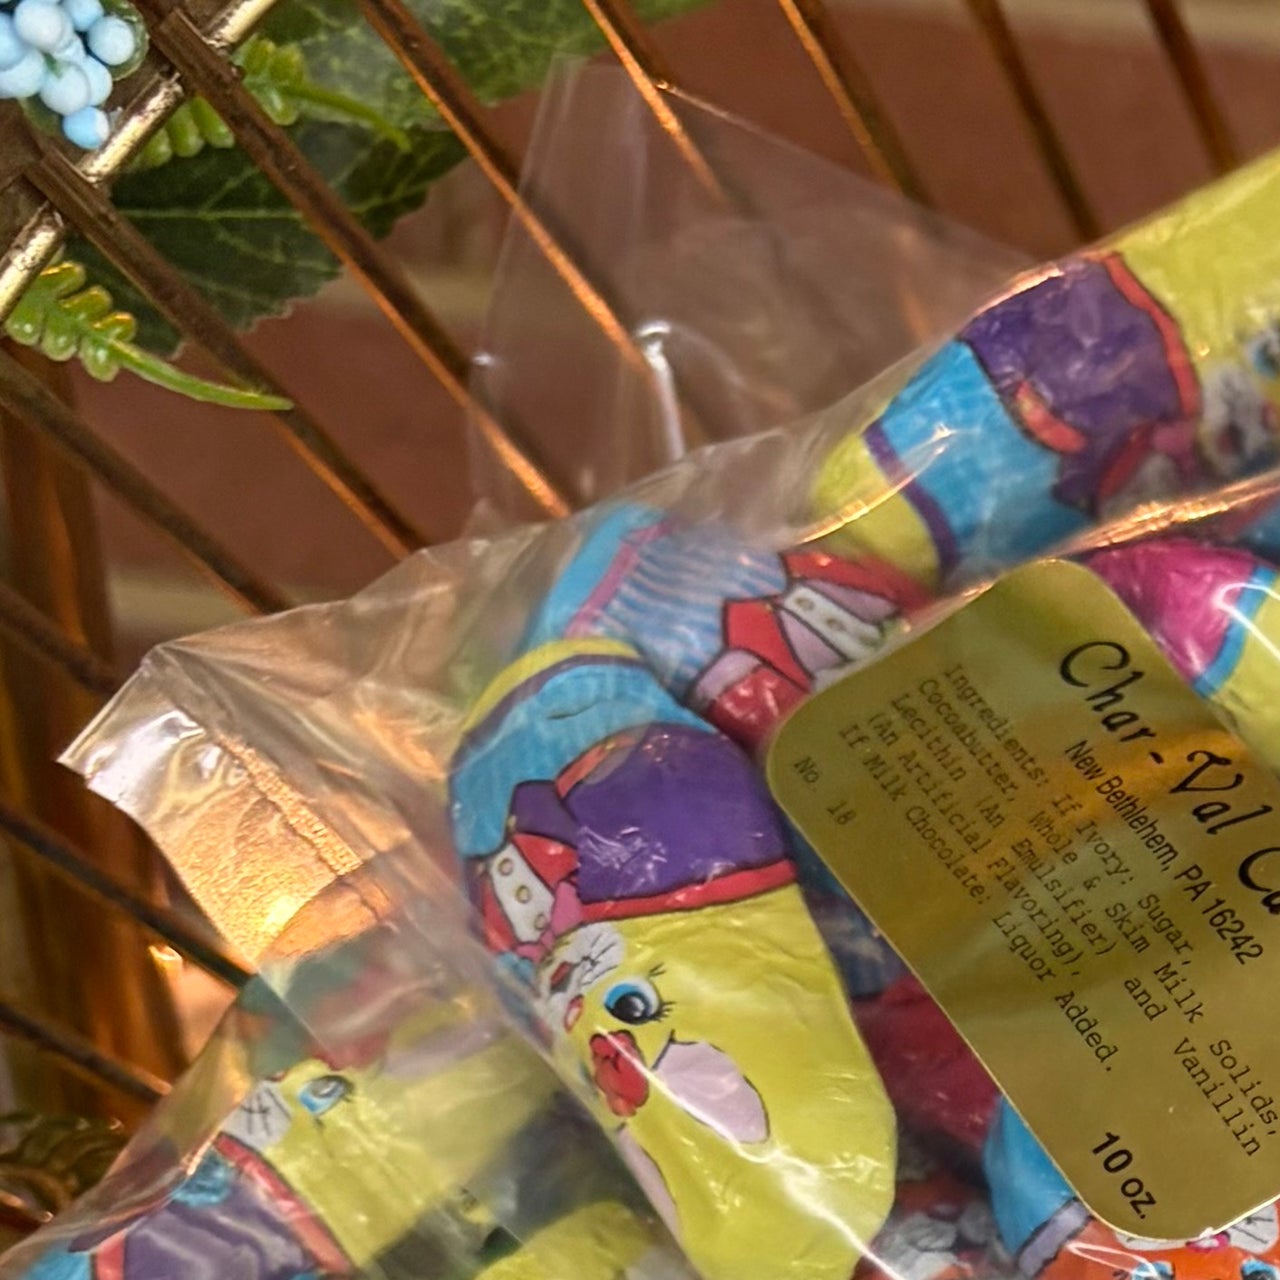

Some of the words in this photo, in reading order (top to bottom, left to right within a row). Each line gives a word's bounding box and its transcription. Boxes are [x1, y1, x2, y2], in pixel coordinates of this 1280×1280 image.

[838, 722, 870, 749] If
[861, 753, 907, 802] Milk
[904, 805, 991, 905] Chocolate:
[991, 910, 1057, 981] Liquor
[1053, 990, 1119, 1072] Added.
[868, 713, 900, 747] (An
[896, 749, 993, 855] Artificial
[985, 855, 1084, 976] Flavoring),
[889, 692, 967, 782] Lecithin
[975, 800, 1005, 829] (An
[1009, 836, 1117, 956] Emulsifier)
[1123, 977, 1168, 1021] and
[1173, 1036, 1271, 1157] Vanillin
[917, 678, 1019, 802] Cocoabutter,
[1027, 809, 1078, 865] Whole
[1081, 875, 1101, 891] &
[1103, 901, 1151, 954] Skim
[1152, 961, 1204, 1024] Milk
[1208, 1038, 1279, 1135] Solids,
[942, 663, 1049, 788] Ingredients:
[1050, 792, 1083, 816] If
[1074, 819, 1134, 885] Ivory:
[1136, 892, 1194, 966] Sugar,
[1063, 739, 1106, 790] New
[1094, 774, 1179, 872] Bethlehem,
[1173, 863, 1212, 902] PA
[1201, 897, 1264, 965] 16242
[1091, 1131, 1133, 1173] 10
[1119, 1176, 1156, 1219] oz.
